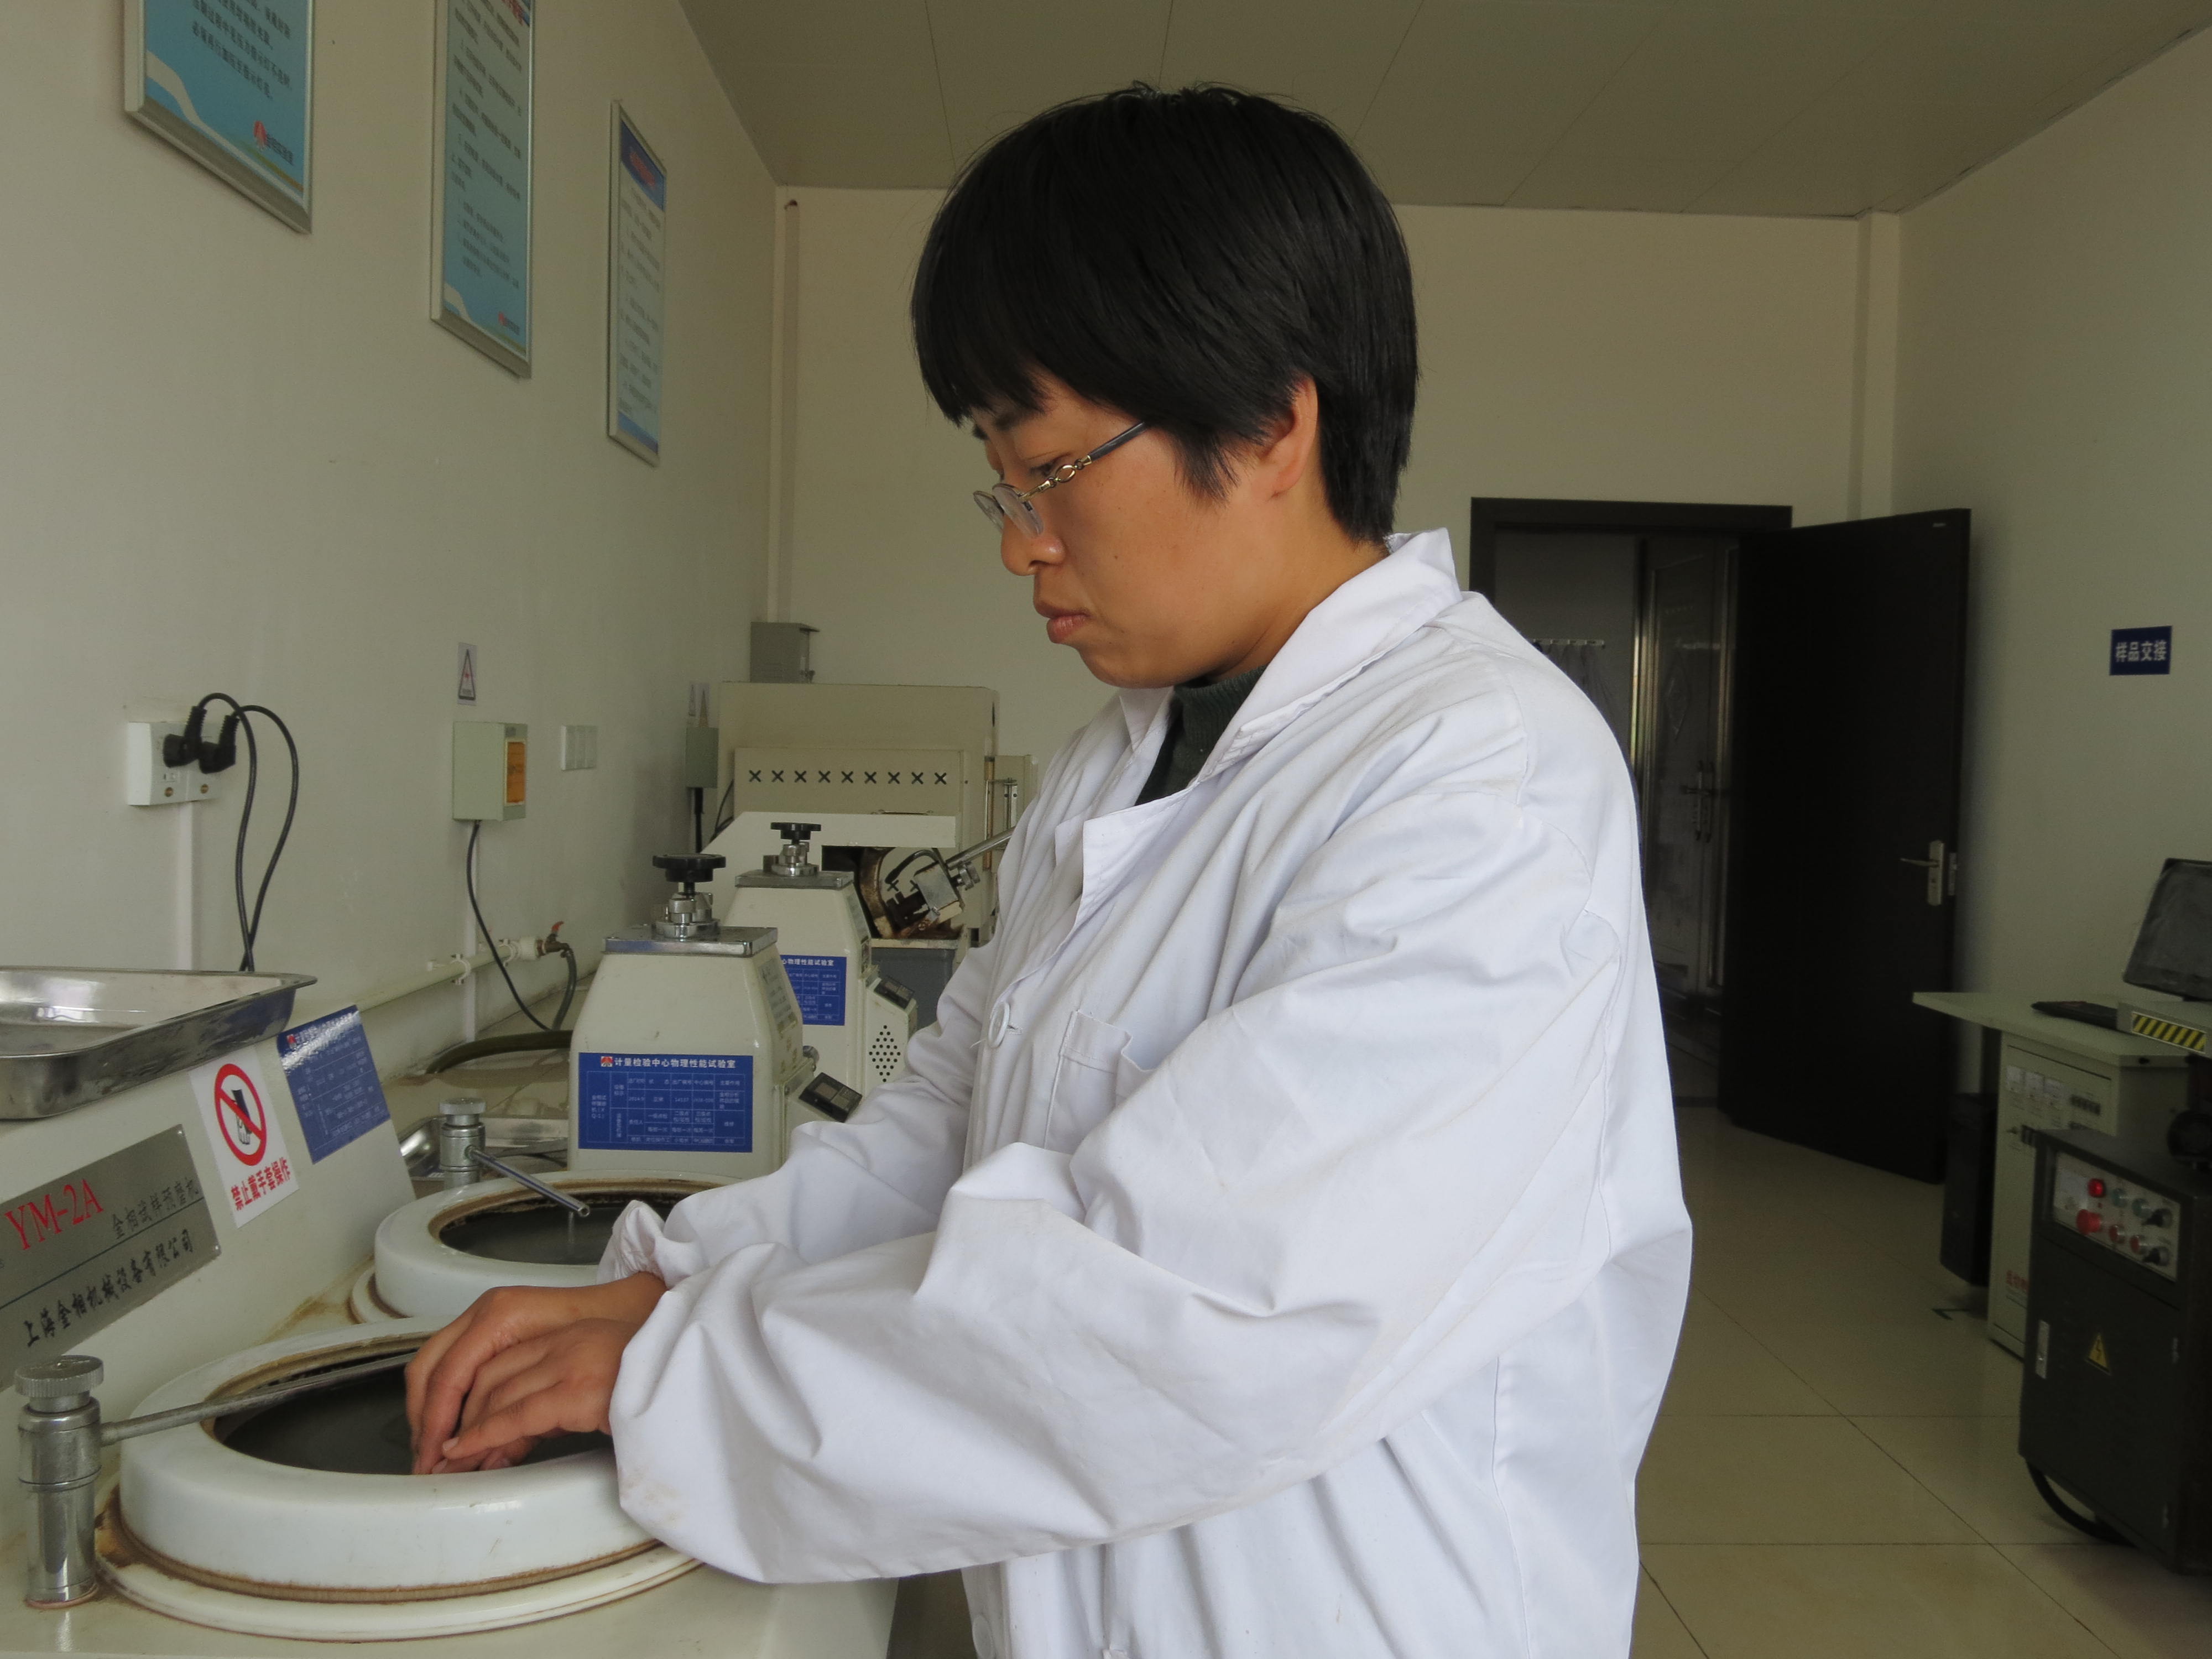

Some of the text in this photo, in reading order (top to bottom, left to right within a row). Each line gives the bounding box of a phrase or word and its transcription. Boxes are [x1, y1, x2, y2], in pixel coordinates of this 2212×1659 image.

[2116, 639, 2167, 662] 样品交接
[614, 1057, 736, 1069] 计量检验中心物理性能试验室
[231, 1157, 290, 1211] 禁止戴手套操作
[4, 1178, 104, 1250] YM-2A
